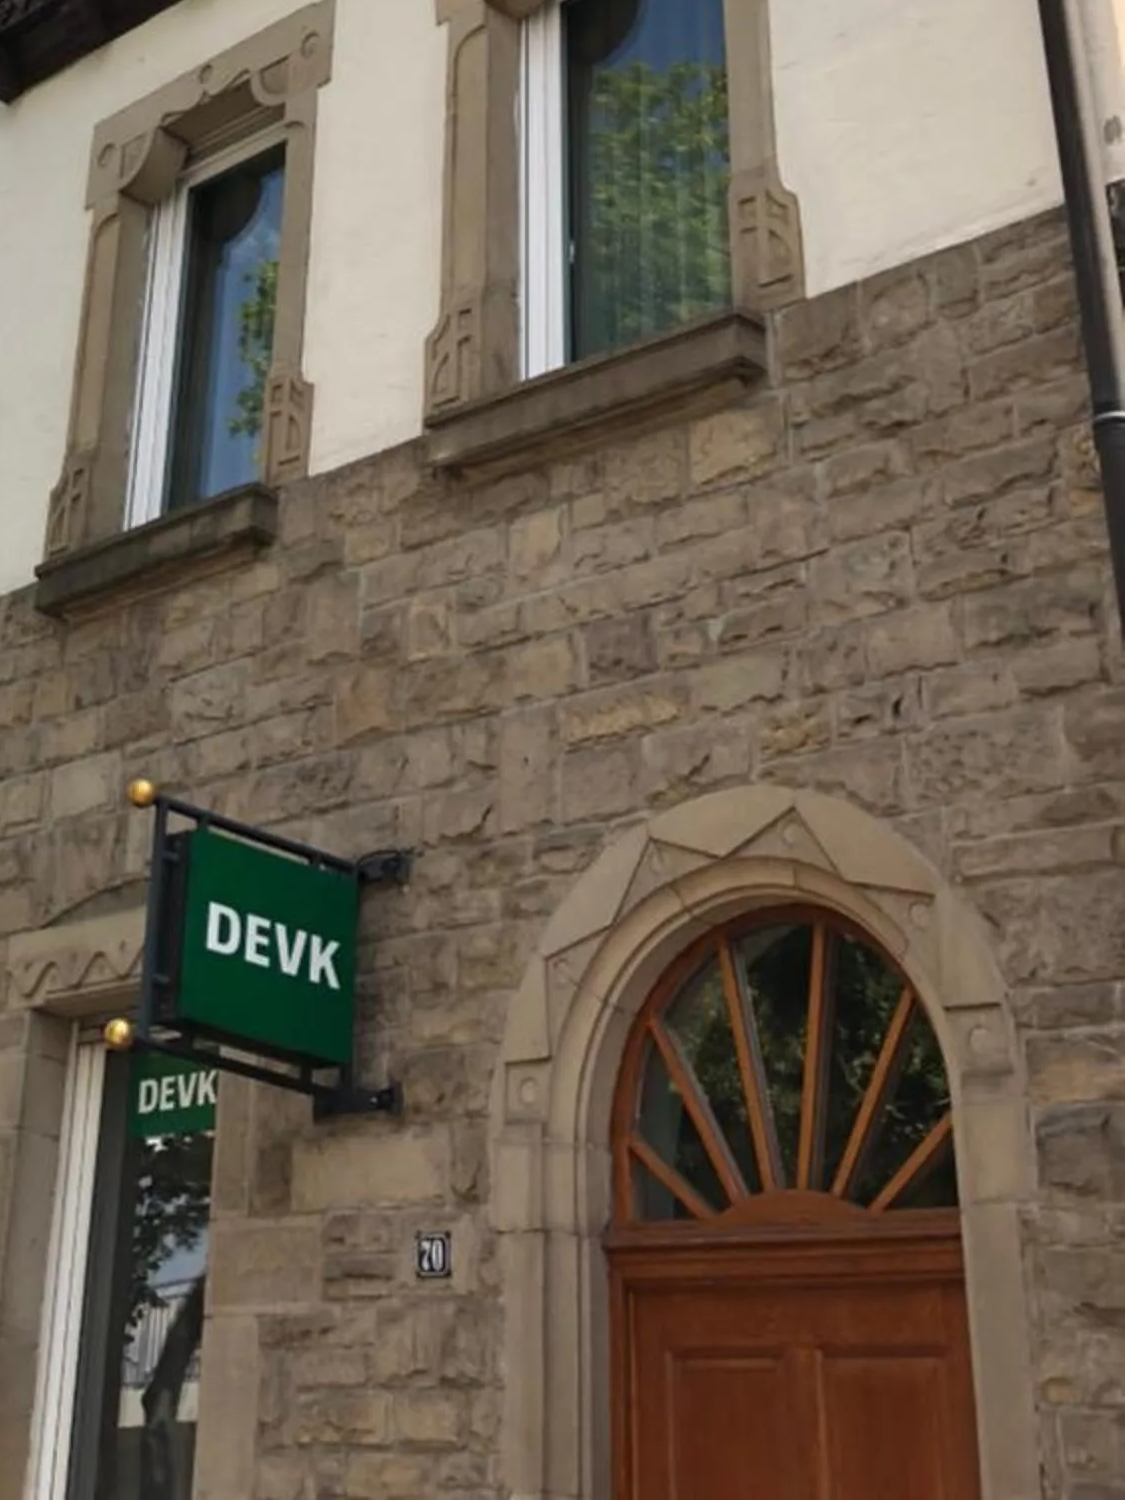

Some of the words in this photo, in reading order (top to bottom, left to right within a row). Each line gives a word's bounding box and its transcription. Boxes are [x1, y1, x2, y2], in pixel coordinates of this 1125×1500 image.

[205, 901, 341, 989] DEVK
[137, 1069, 218, 1114] DEVK
[420, 1239, 444, 1270] 70
